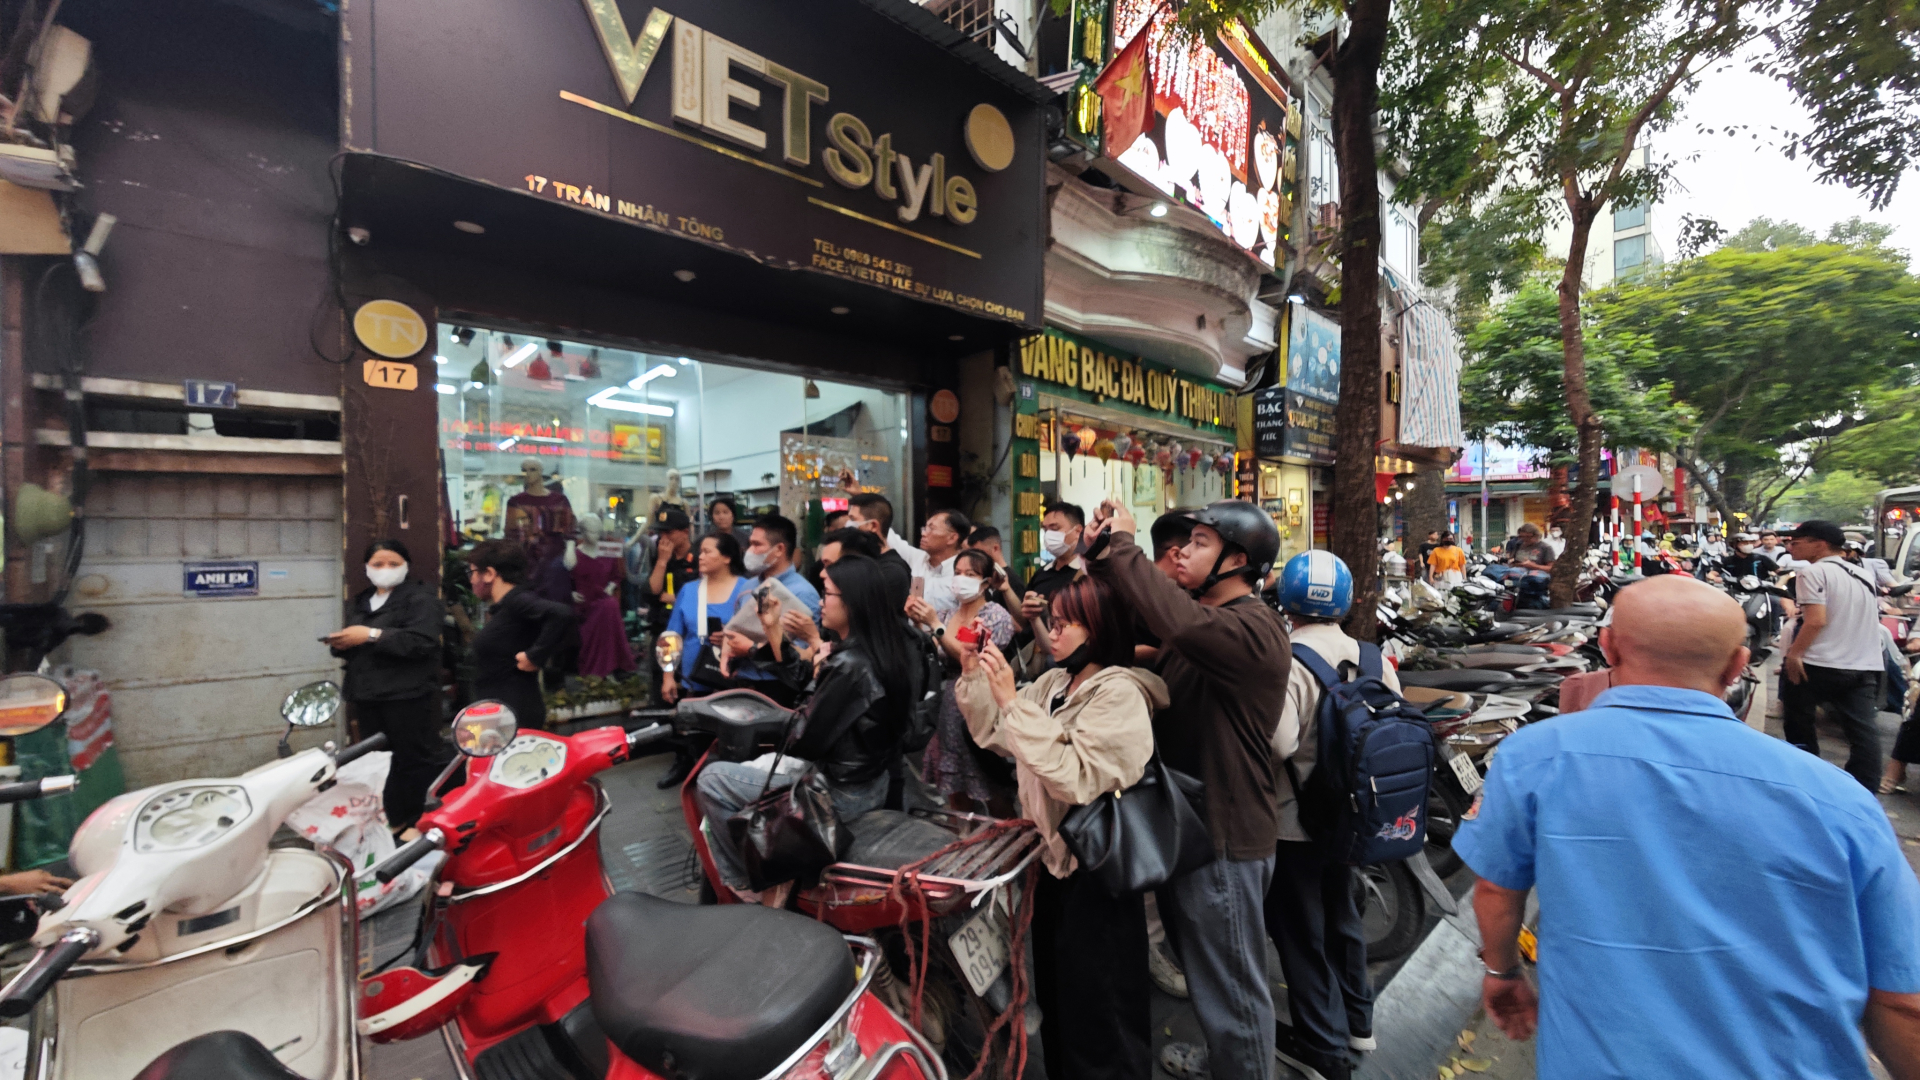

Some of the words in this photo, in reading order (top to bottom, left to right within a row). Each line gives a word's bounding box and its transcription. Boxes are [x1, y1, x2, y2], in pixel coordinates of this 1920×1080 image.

[525, 174, 548, 193] 17
[617, 204, 669, 227] NHÂN
[677, 216, 724, 241] TÔNG
[985, 301, 1005, 316] CHO
[377, 366, 407, 384] 17
[1081, 346, 1119, 402] BẠC
[1122, 356, 1145, 405] ĐÁ
[1147, 368, 1178, 413] QUÝ
[195, 383, 226, 404] 17
[1022, 384, 1031, 398] 19
[1257, 402, 1282, 417] BẠC
[195, 572, 226, 585] ANH
[229, 572, 249, 585] EM
[1311, 588, 1330, 598] WD
